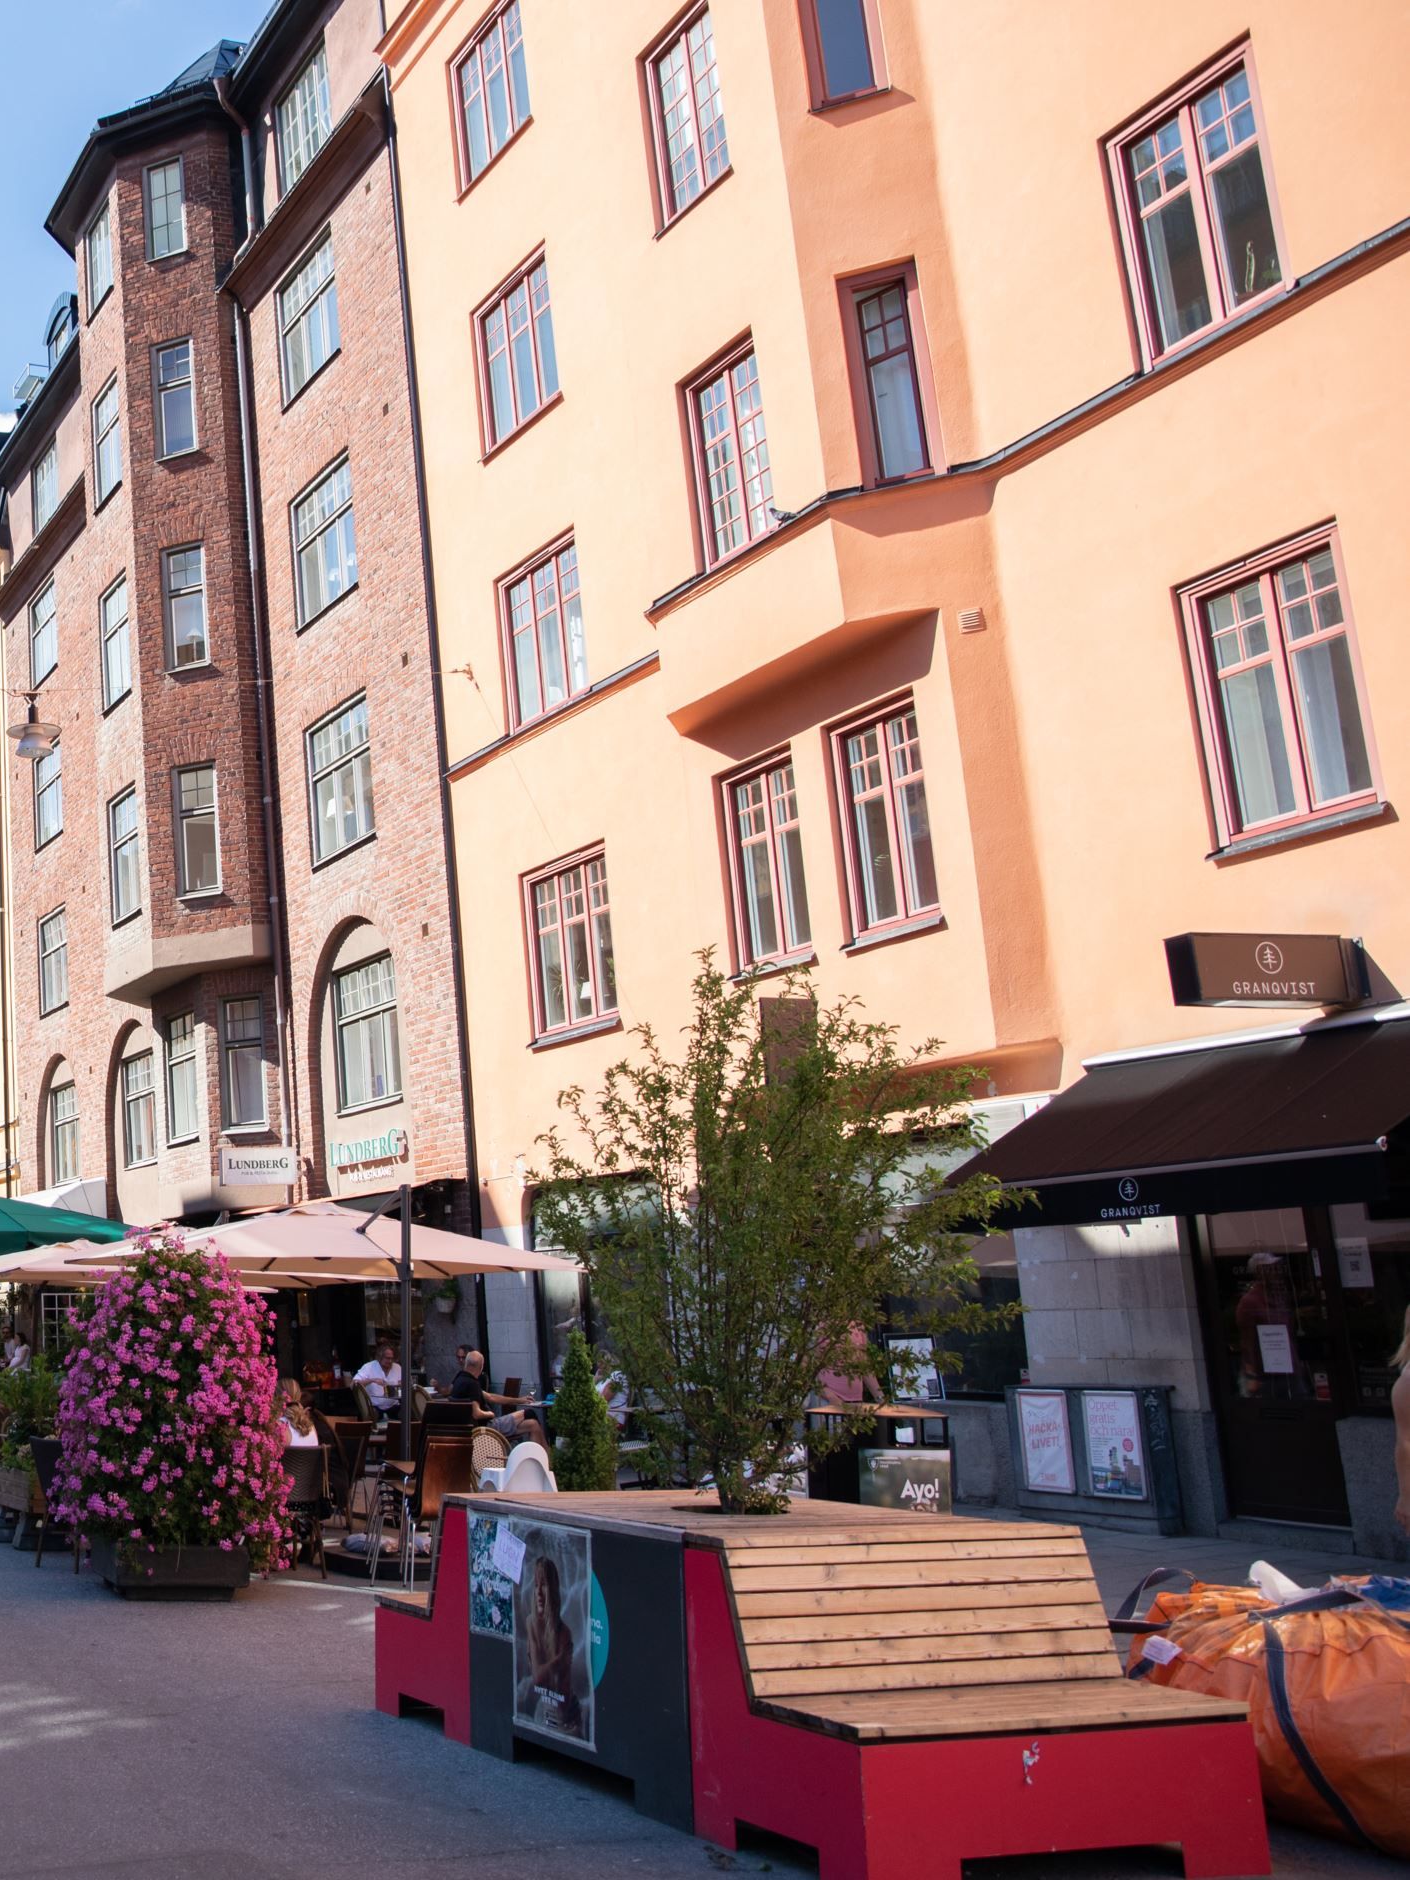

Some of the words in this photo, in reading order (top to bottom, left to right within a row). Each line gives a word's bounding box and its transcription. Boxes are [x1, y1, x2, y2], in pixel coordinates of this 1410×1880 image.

[1232, 981, 1315, 995] GRANQVIST
[329, 1128, 399, 1168] LUNDBERG
[228, 1157, 289, 1170] LUNDBERG
[1100, 1203, 1161, 1218] GRANQVIST
[900, 1478, 939, 1504] Ayo!
